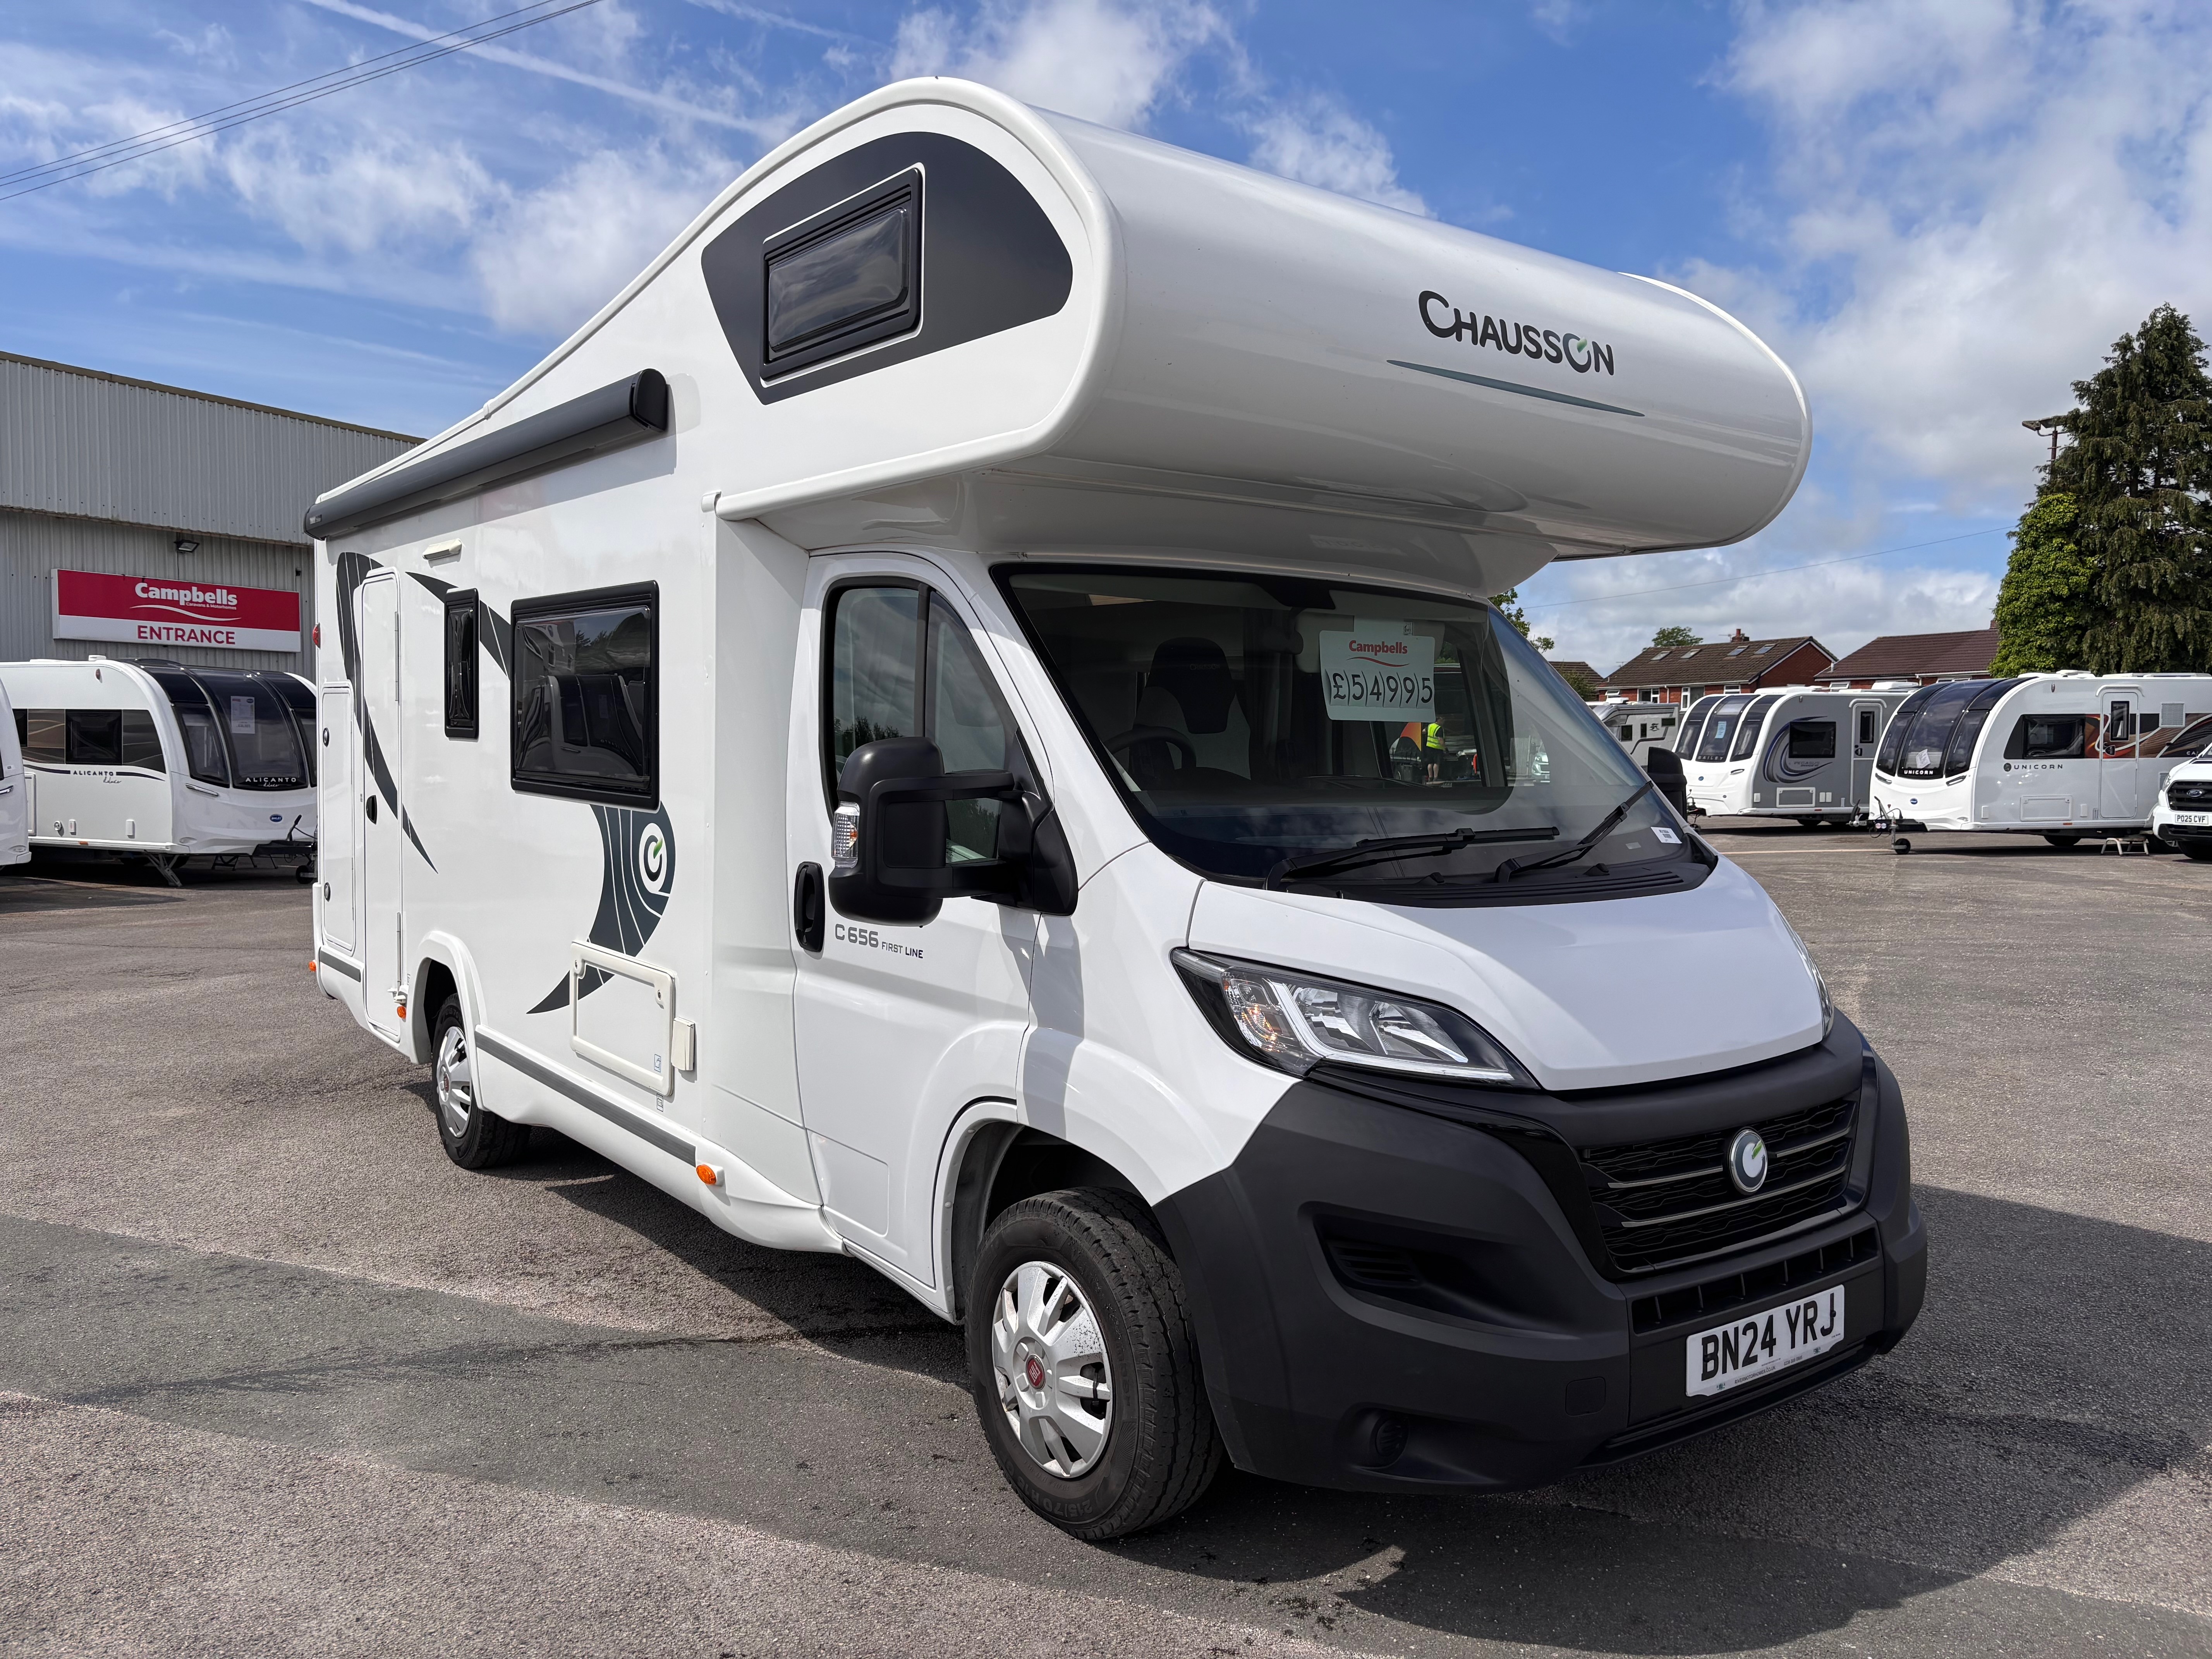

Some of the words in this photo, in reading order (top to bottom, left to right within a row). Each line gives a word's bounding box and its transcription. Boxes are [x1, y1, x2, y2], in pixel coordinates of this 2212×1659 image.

[1419, 290, 1614, 376] CHAUSSON
[135, 582, 237, 606] Campbells
[137, 625, 235, 645] ENTRANCE
[1349, 640, 1408, 655] Campbells
[1333, 673, 1433, 704] £54995
[835, 924, 845, 940] C
[848, 927, 879, 948] 656
[882, 941, 903, 953] FIRST
[905, 947, 923, 958] LINE
[1701, 1314, 1776, 1381] BN24
[1786, 1293, 1835, 1349] YRJ
[1029, 1362, 1041, 1383] FIAT
